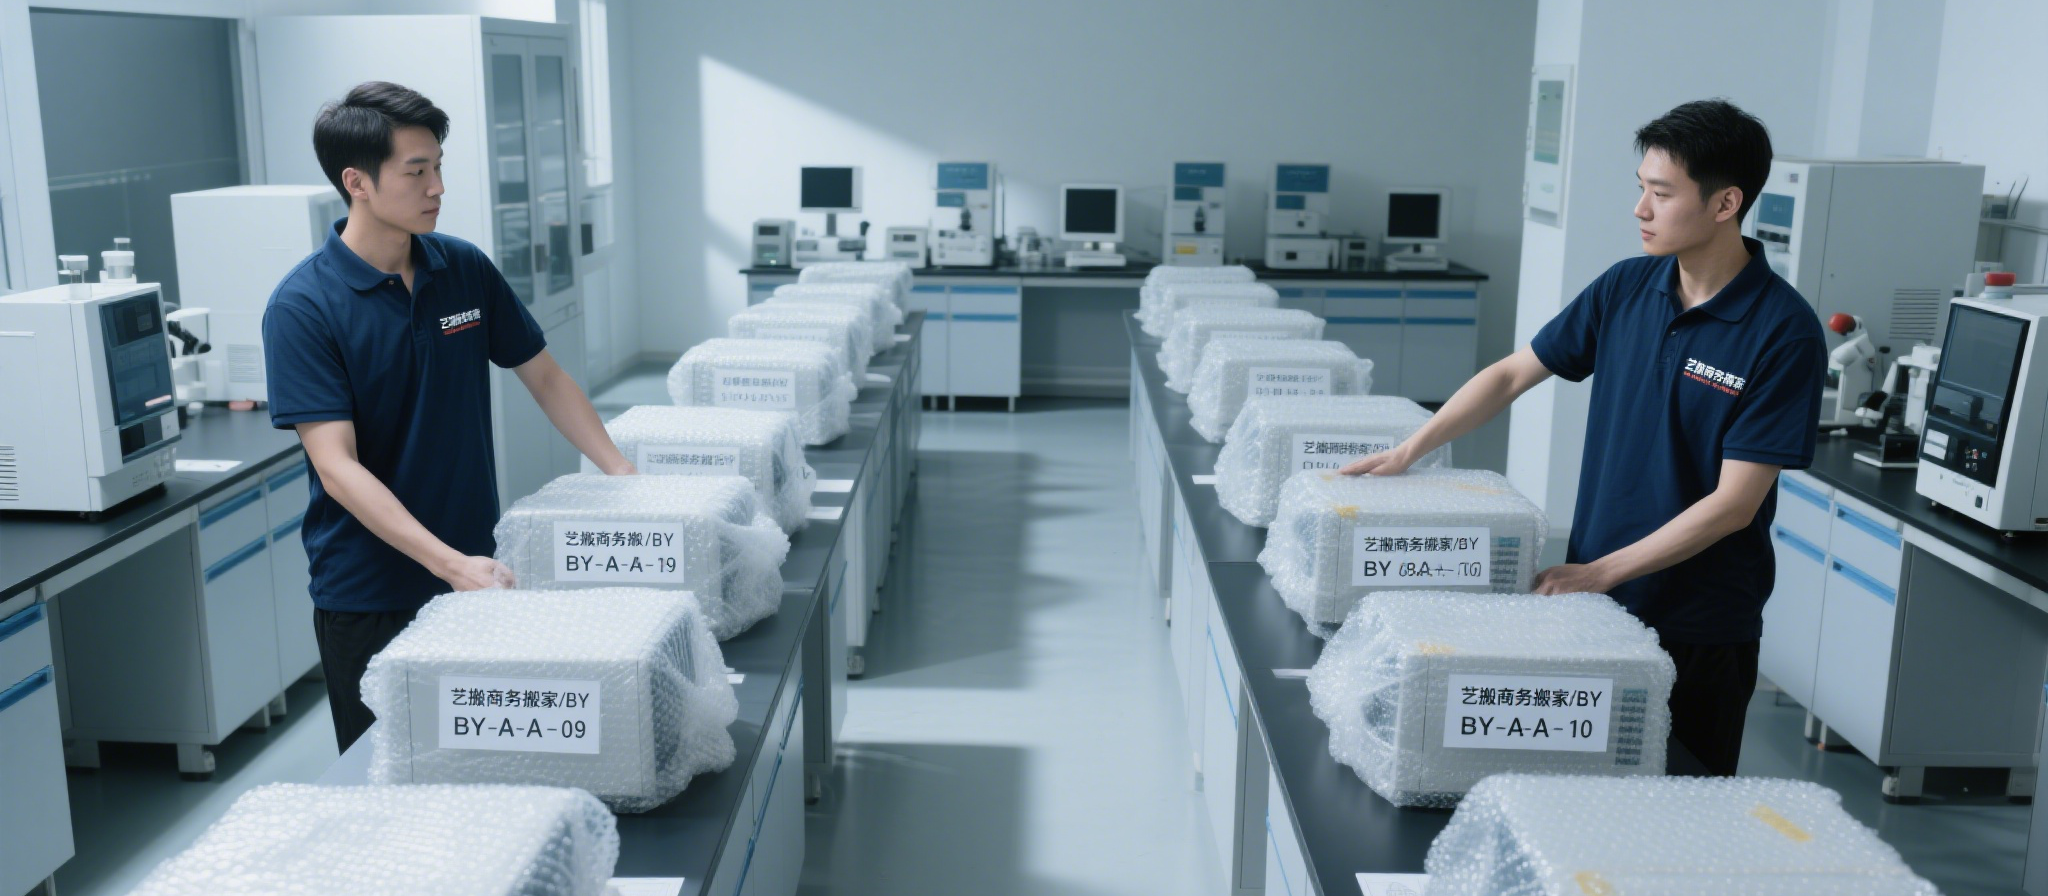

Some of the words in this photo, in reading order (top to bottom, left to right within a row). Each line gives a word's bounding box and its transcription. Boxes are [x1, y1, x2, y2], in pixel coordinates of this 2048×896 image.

[450, 687, 590, 708] 艺搬商务搬家/BY
[1461, 686, 1603, 707] 艺搬商务搬家/BY
[454, 717, 587, 739] BY-A-A-09
[1461, 716, 1593, 738] BY-A-A-10
